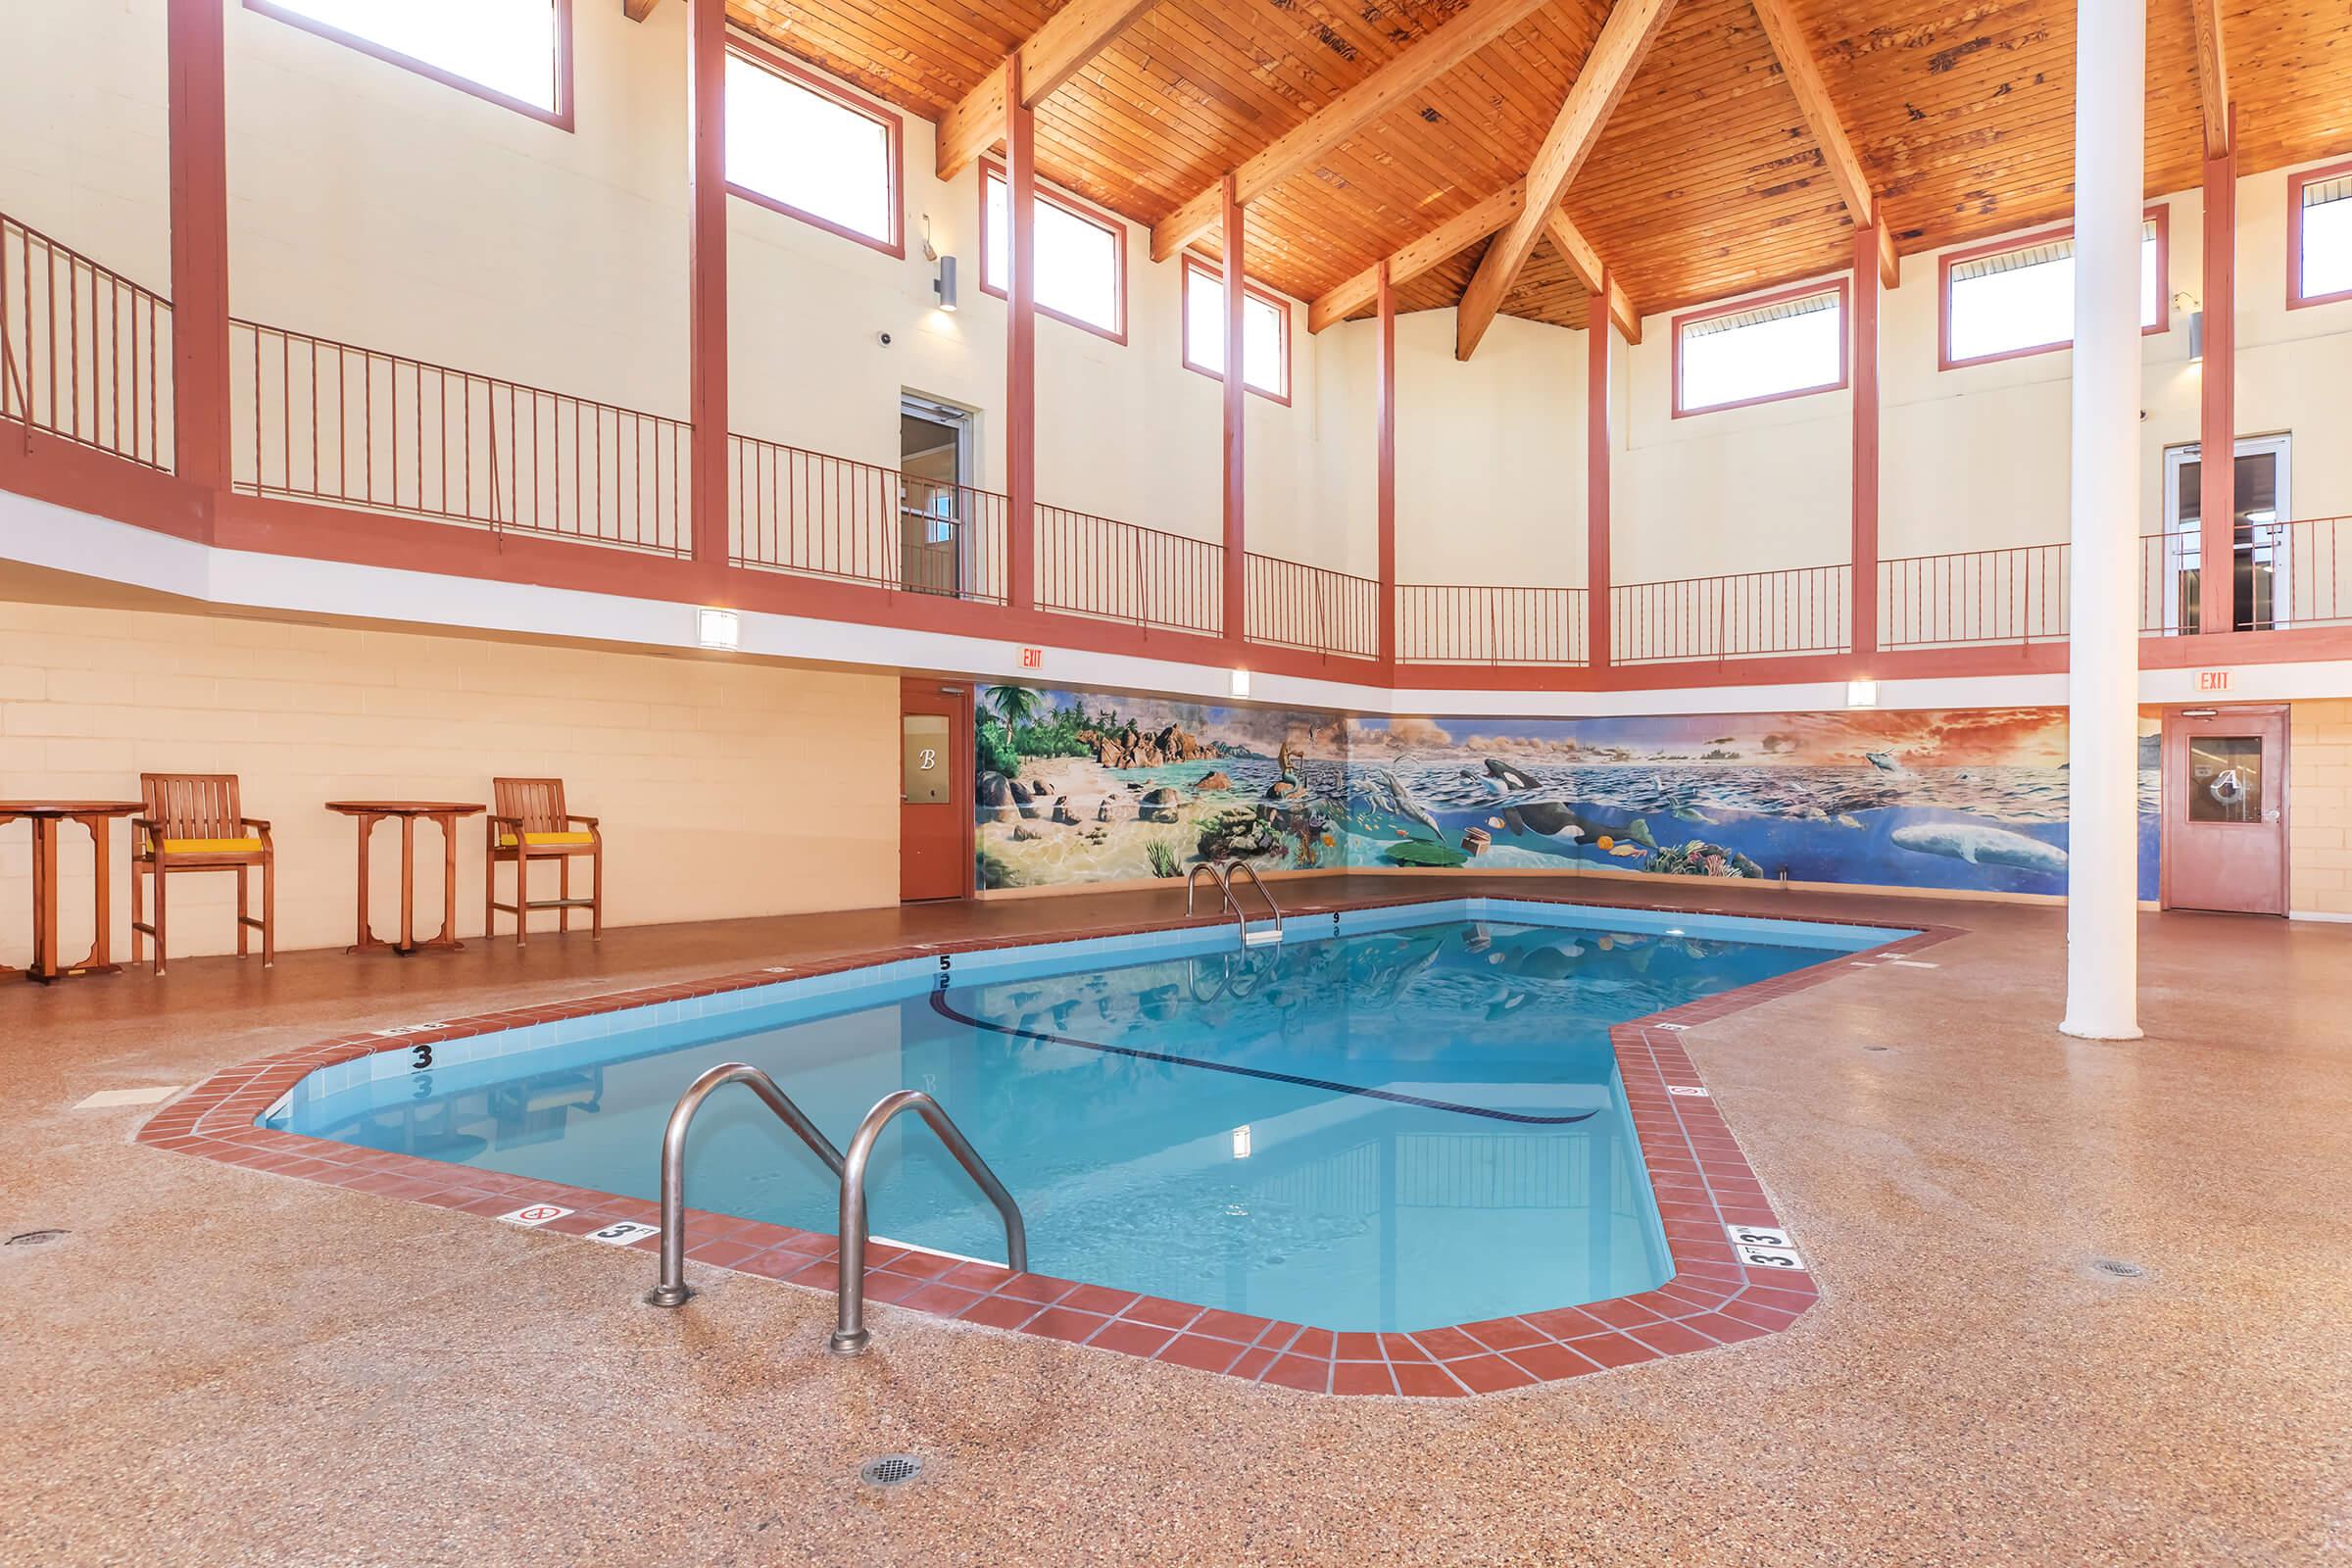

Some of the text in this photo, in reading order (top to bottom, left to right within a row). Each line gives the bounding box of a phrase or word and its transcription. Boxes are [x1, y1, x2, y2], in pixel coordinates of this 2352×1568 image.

[1023, 648, 1043, 667] EXIT
[2201, 671, 2229, 690] EXIT
[919, 749, 935, 769] B
[2210, 769, 2241, 789] A
[1333, 911, 1340, 923] 9
[940, 955, 951, 970] 5
[412, 1045, 433, 1069] 3
[597, 1224, 637, 1239] 3
[1740, 1234, 1782, 1245] 3
[1749, 1254, 1794, 1266] 3
